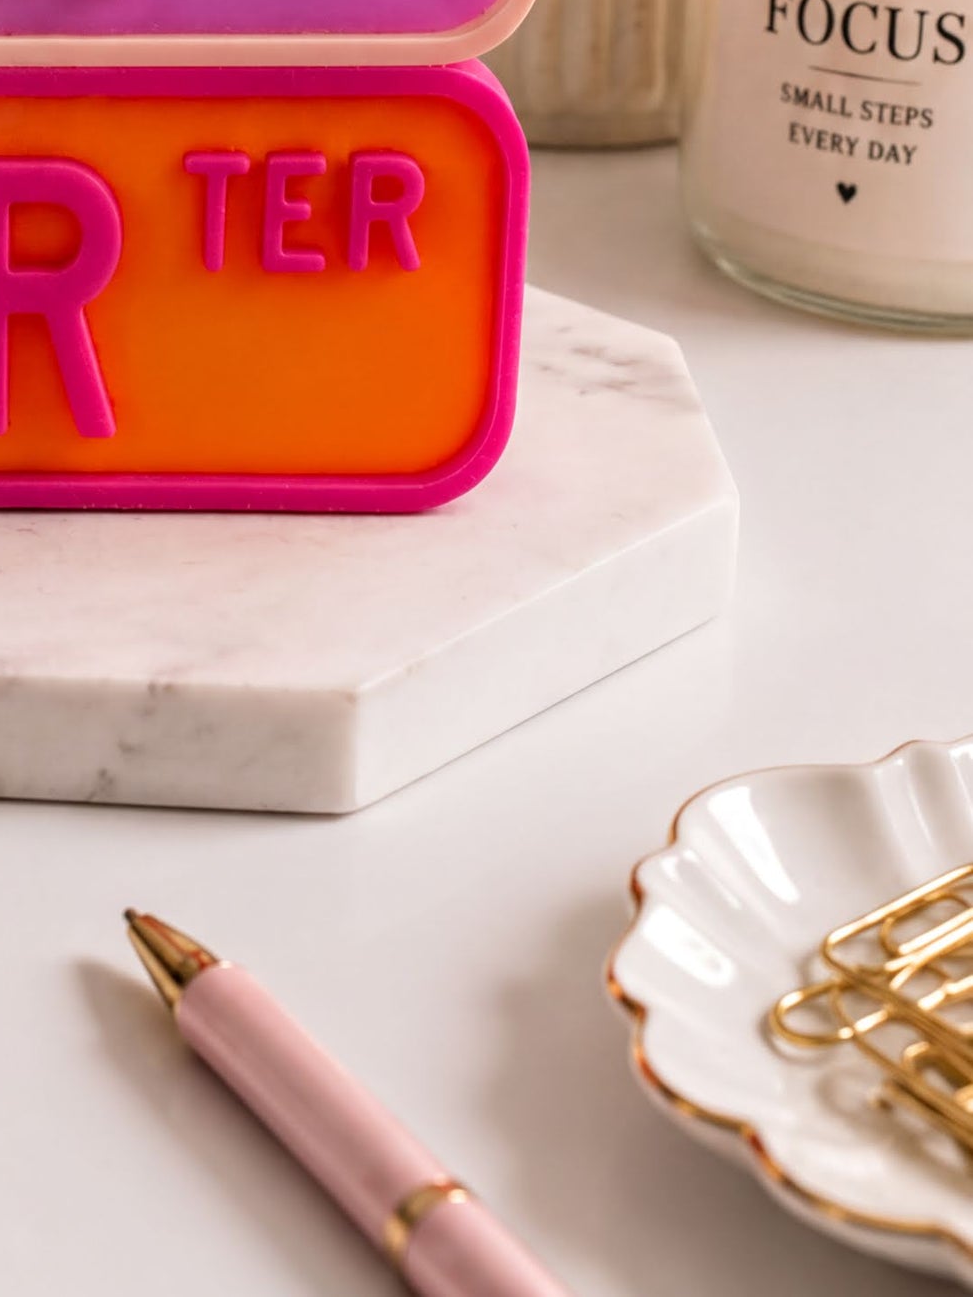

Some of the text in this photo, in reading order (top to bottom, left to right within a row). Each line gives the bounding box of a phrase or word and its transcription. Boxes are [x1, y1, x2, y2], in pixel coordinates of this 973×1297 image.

[779, 81, 935, 130] SMALL STEPS
[788, 122, 918, 167] EVERY DAY
[183, 149, 427, 273] TER
